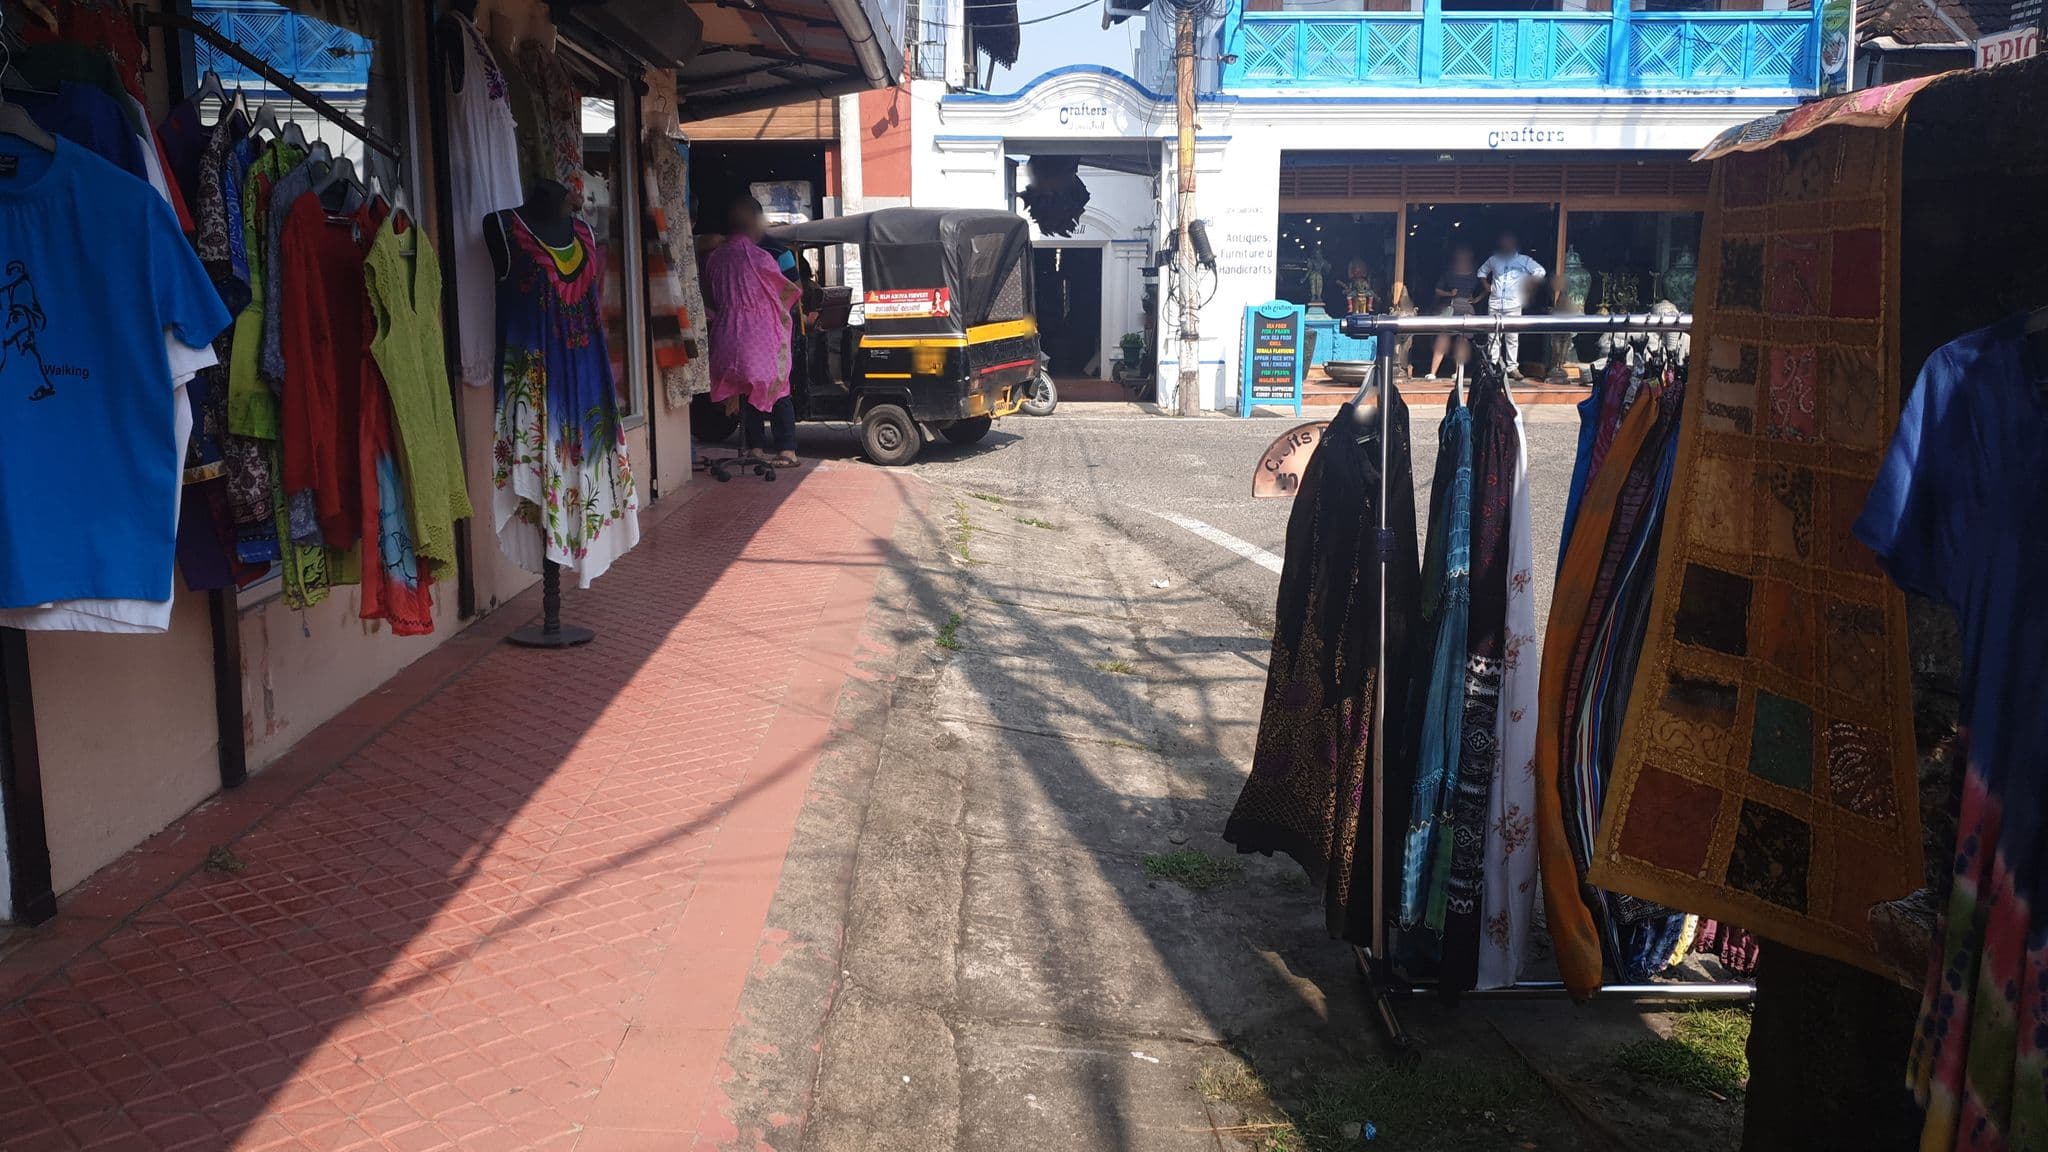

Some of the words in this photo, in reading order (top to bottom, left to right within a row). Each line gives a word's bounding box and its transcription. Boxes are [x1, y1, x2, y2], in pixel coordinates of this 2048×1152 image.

[1060, 102, 1107, 124] Crafters
[1488, 127, 1565, 148] Crafters
[1219, 264, 1273, 275] Handicrafts
[43, 364, 89, 379] Walking
